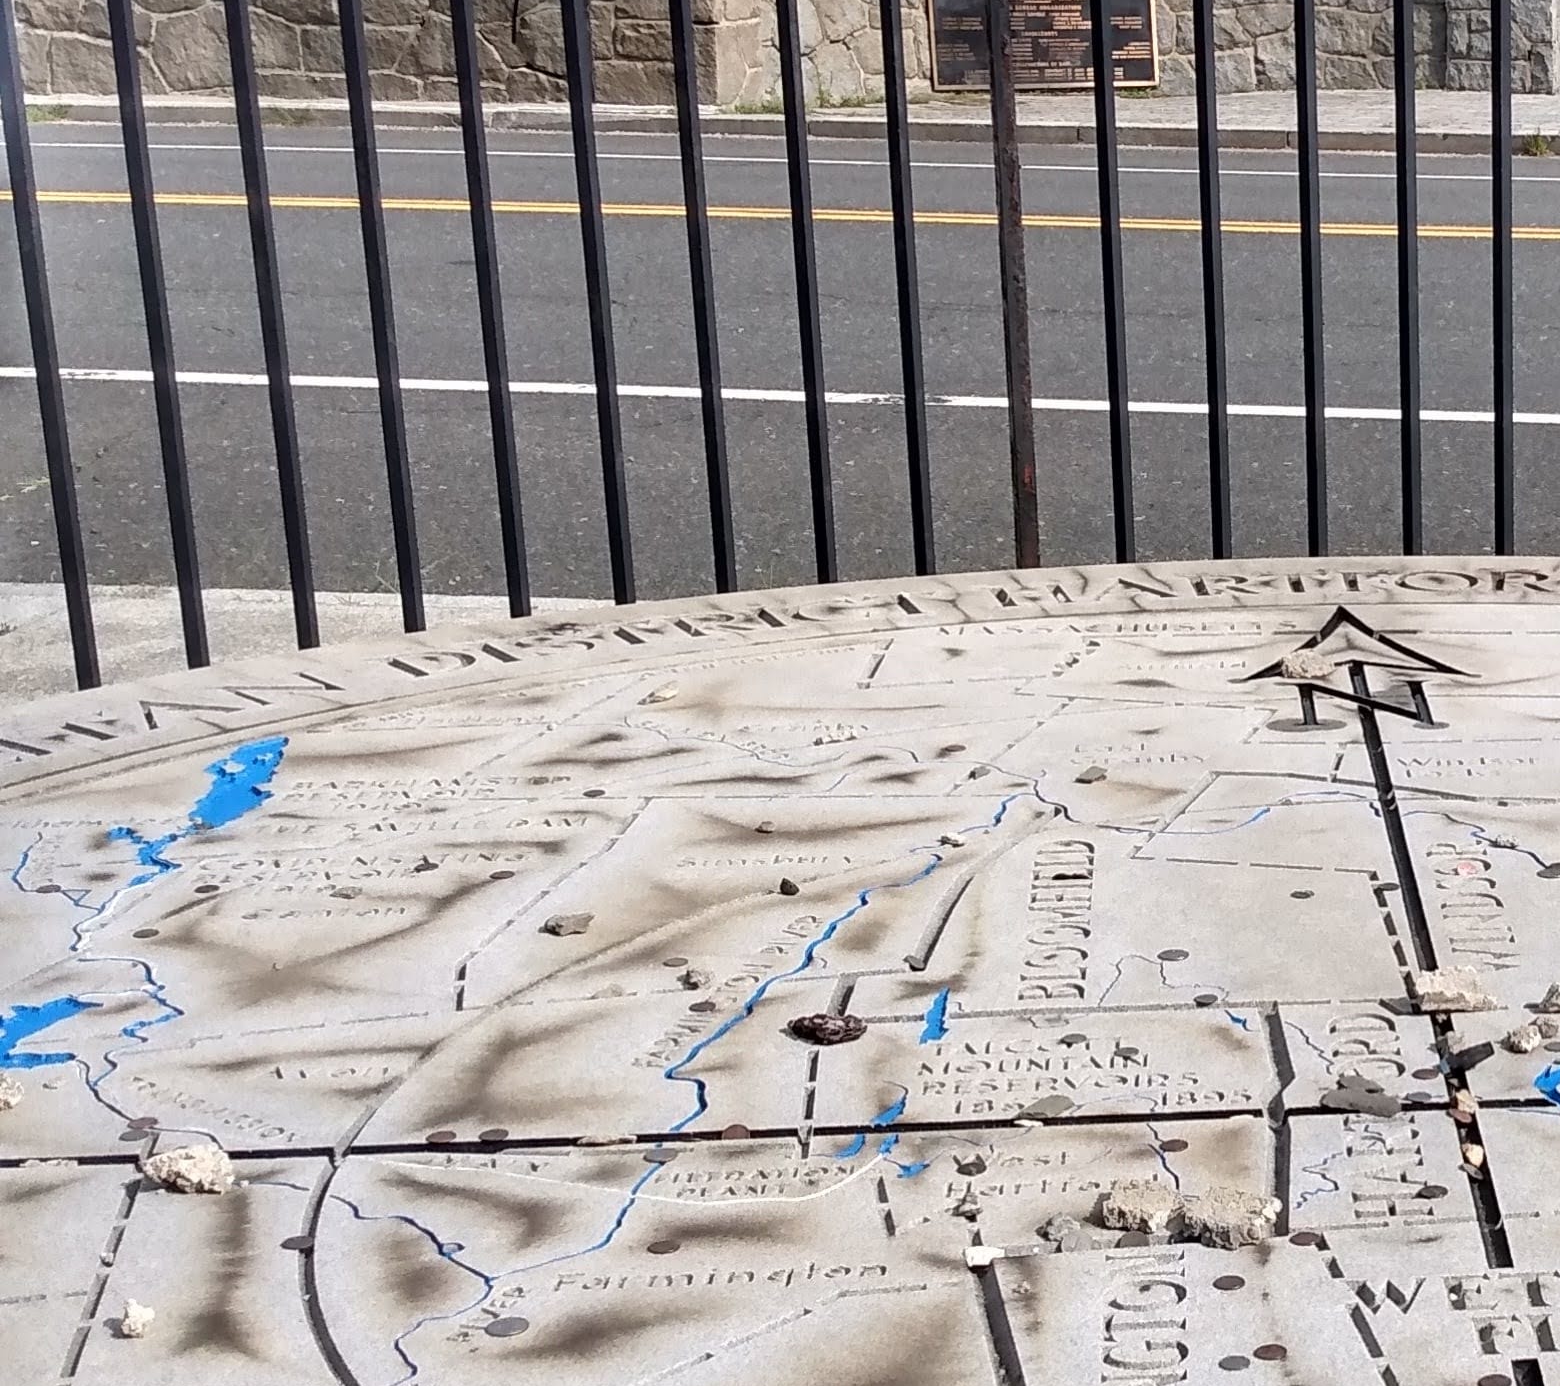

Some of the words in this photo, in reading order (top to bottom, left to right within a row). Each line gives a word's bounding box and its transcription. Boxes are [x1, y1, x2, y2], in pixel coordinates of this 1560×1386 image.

[1017, 838, 1095, 1001] BLOOMFIELD
[918, 1053, 1149, 1076] MOUNTAIN
[921, 1072, 1199, 1095] RESERVOIRS
[554, 1261, 888, 1292] Farmington
